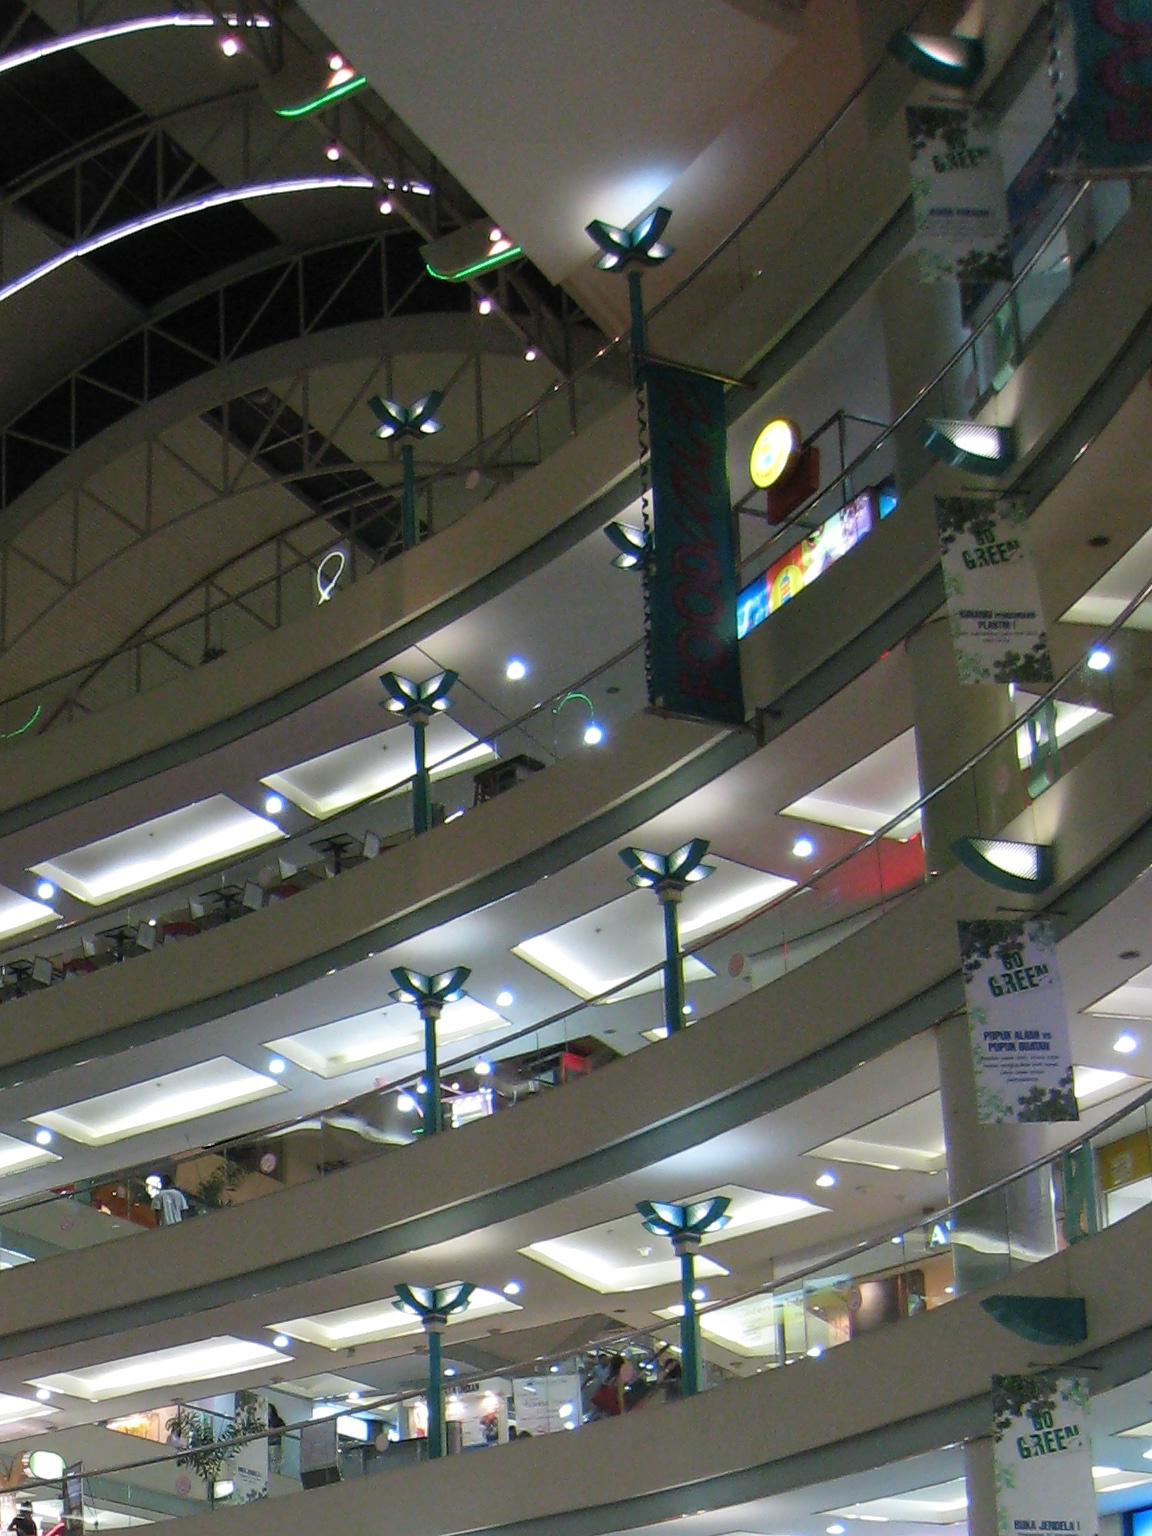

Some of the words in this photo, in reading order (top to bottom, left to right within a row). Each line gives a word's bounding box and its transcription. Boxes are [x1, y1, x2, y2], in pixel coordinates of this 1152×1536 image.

[988, 964, 1048, 997] GREEN
[1016, 1424, 1080, 1459] GREEN
[1039, 1520, 1075, 1530] JENDELA
